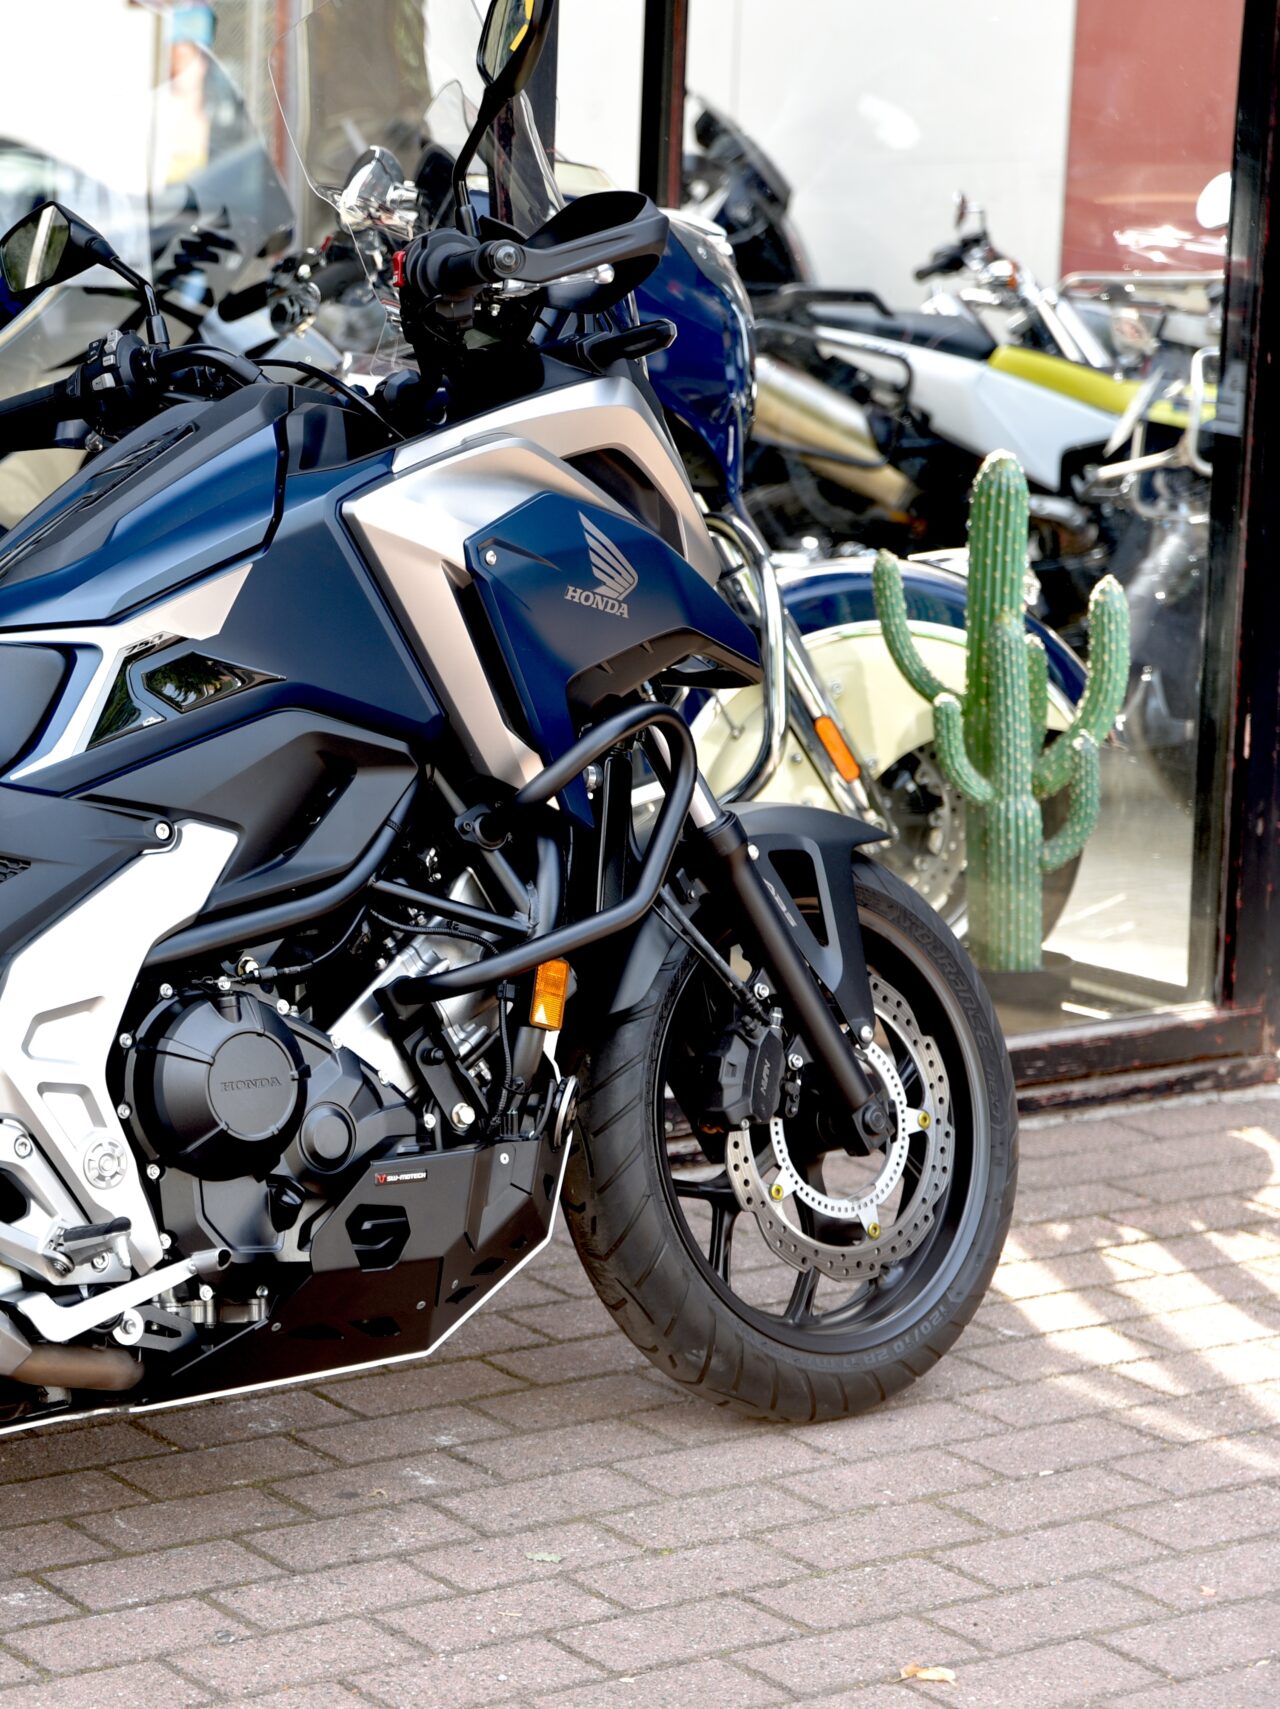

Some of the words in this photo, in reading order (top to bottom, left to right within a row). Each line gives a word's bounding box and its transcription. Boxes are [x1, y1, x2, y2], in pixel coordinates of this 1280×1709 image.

[564, 585, 629, 618] HONDA
[125, 634, 163, 654] 750
[762, 877, 797, 927] ABS
[220, 1076, 282, 1092] HONDA
[386, 1172, 427, 1182] SW-MOTECH
